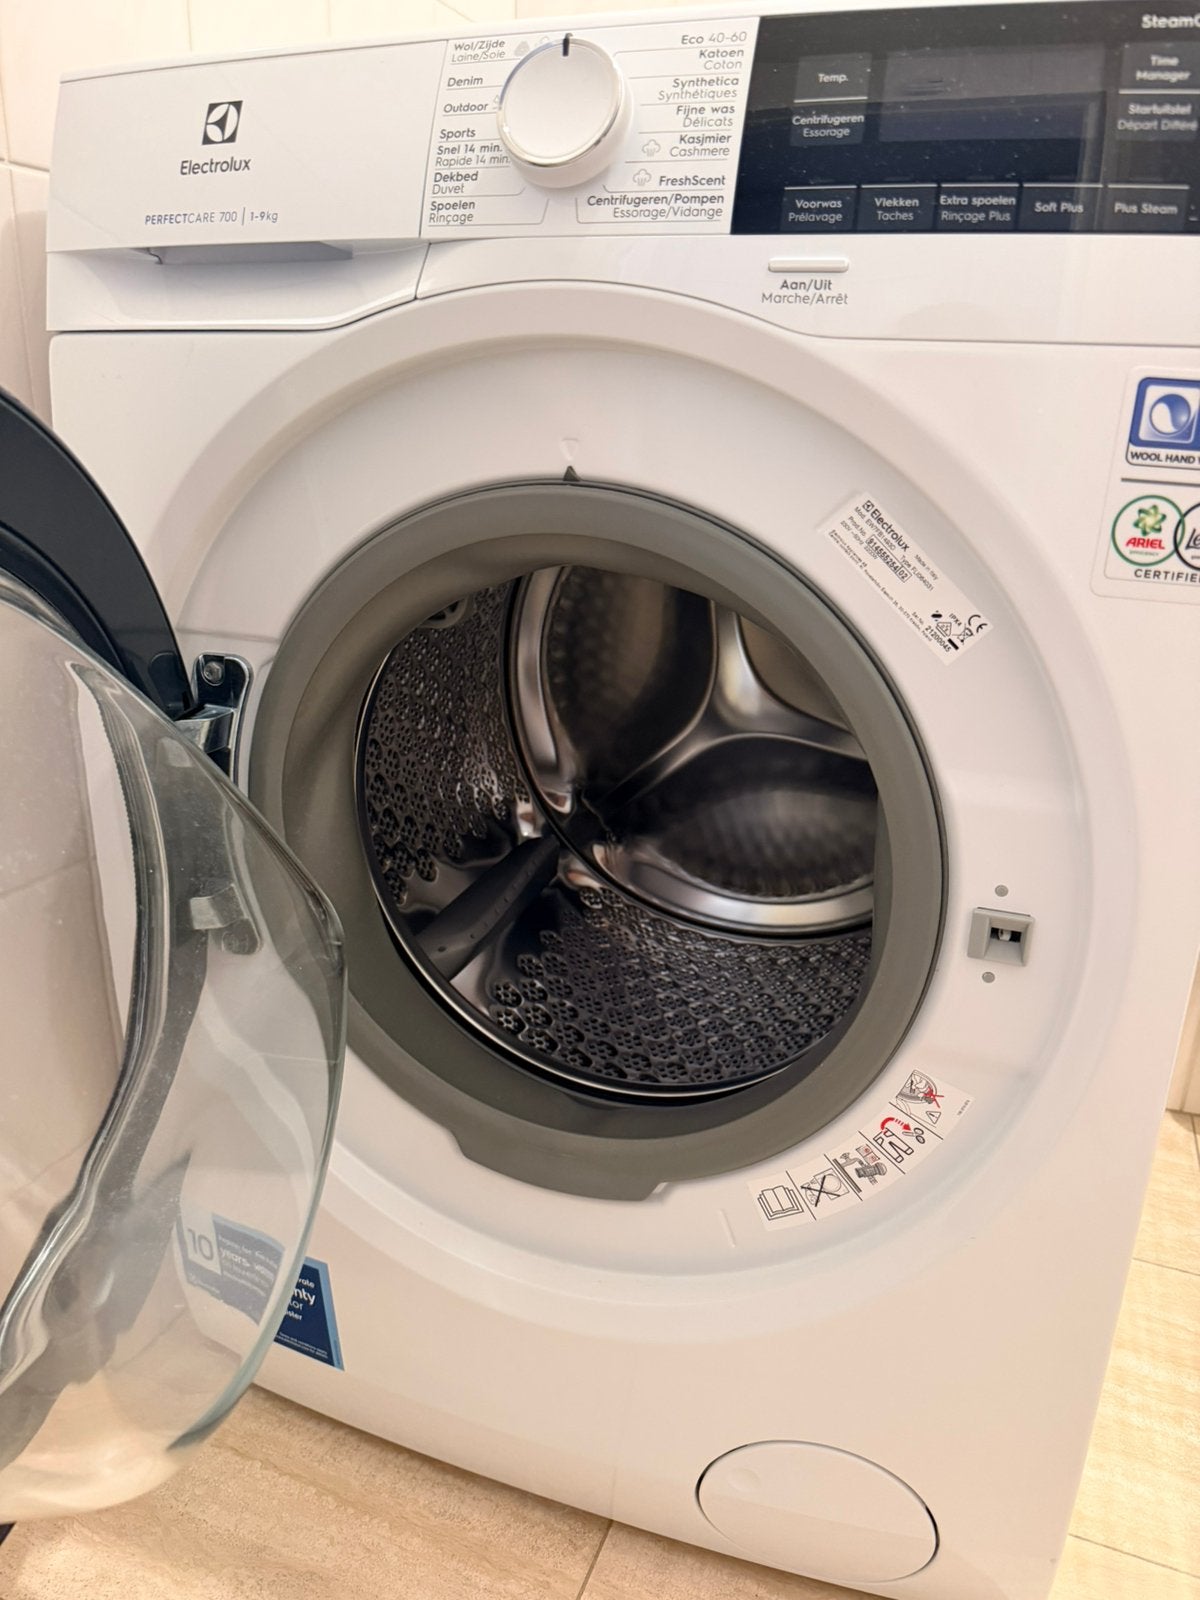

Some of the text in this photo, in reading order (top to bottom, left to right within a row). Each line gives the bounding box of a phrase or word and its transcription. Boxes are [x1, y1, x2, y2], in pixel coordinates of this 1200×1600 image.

[681, 31, 747, 45] Eco 40-60
[454, 40, 506, 51] Wol/Zijde
[452, 50, 506, 62] Laine/Soie
[699, 49, 744, 59] Katoen
[1151, 54, 1179, 66] Time
[704, 60, 742, 70] Coton
[448, 76, 484, 88] Denim
[818, 72, 848, 84] Temp.
[1136, 70, 1191, 82] Manager
[672, 76, 740, 90] Synthetica
[658, 88, 738, 102] Synthétiques
[444, 102, 488, 114] Outdoor
[676, 105, 736, 118] Fijne was
[682, 116, 734, 128] Délicats
[792, 113, 865, 126] Centrifugeren
[440, 128, 476, 140] Sports
[678, 133, 732, 146] Kasjmier
[802, 126, 850, 140] Essorage
[437, 142, 503, 156] Snel 14 min.
[670, 146, 730, 158] Cashmere
[180, 156, 252, 176] Electrolux
[435, 154, 511, 168] Rapide 14 min.
[434, 170, 479, 182] Dekbed
[659, 174, 726, 186] FreshScent
[432, 184, 464, 194] Duvet
[430, 200, 476, 212] Spoelen
[587, 193, 725, 208] Centrifugeren/Pompen
[795, 198, 842, 209] Voorwas
[874, 196, 920, 208] Vlekken
[940, 194, 1016, 208] Extra spoelen
[613, 206, 724, 220] Essorage/Vidange
[1034, 201, 1084, 214] Soft Plus
[1114, 202, 1178, 214] Plus Steam
[144, 212, 216, 226] PERFECTCARE
[219, 212, 238, 222] 700
[429, 212, 474, 224] Rinçage
[788, 210, 843, 224] Prélavage
[876, 210, 914, 222] Taches
[940, 209, 1011, 224] Rinçage Plus
[780, 278, 832, 292] Aan/Uit
[761, 291, 848, 306] Marche/Arrêt
[1130, 452, 1162, 462] WOOL
[1165, 453, 1196, 464] HAND
[869, 507, 911, 552] Electrolux
[1126, 537, 1166, 550] ARIEL
[867, 537, 900, 571] 914555254
[898, 554, 912, 569] Type
[1134, 568, 1200, 583] CERTIFIE
[924, 624, 951, 653] 21200045
